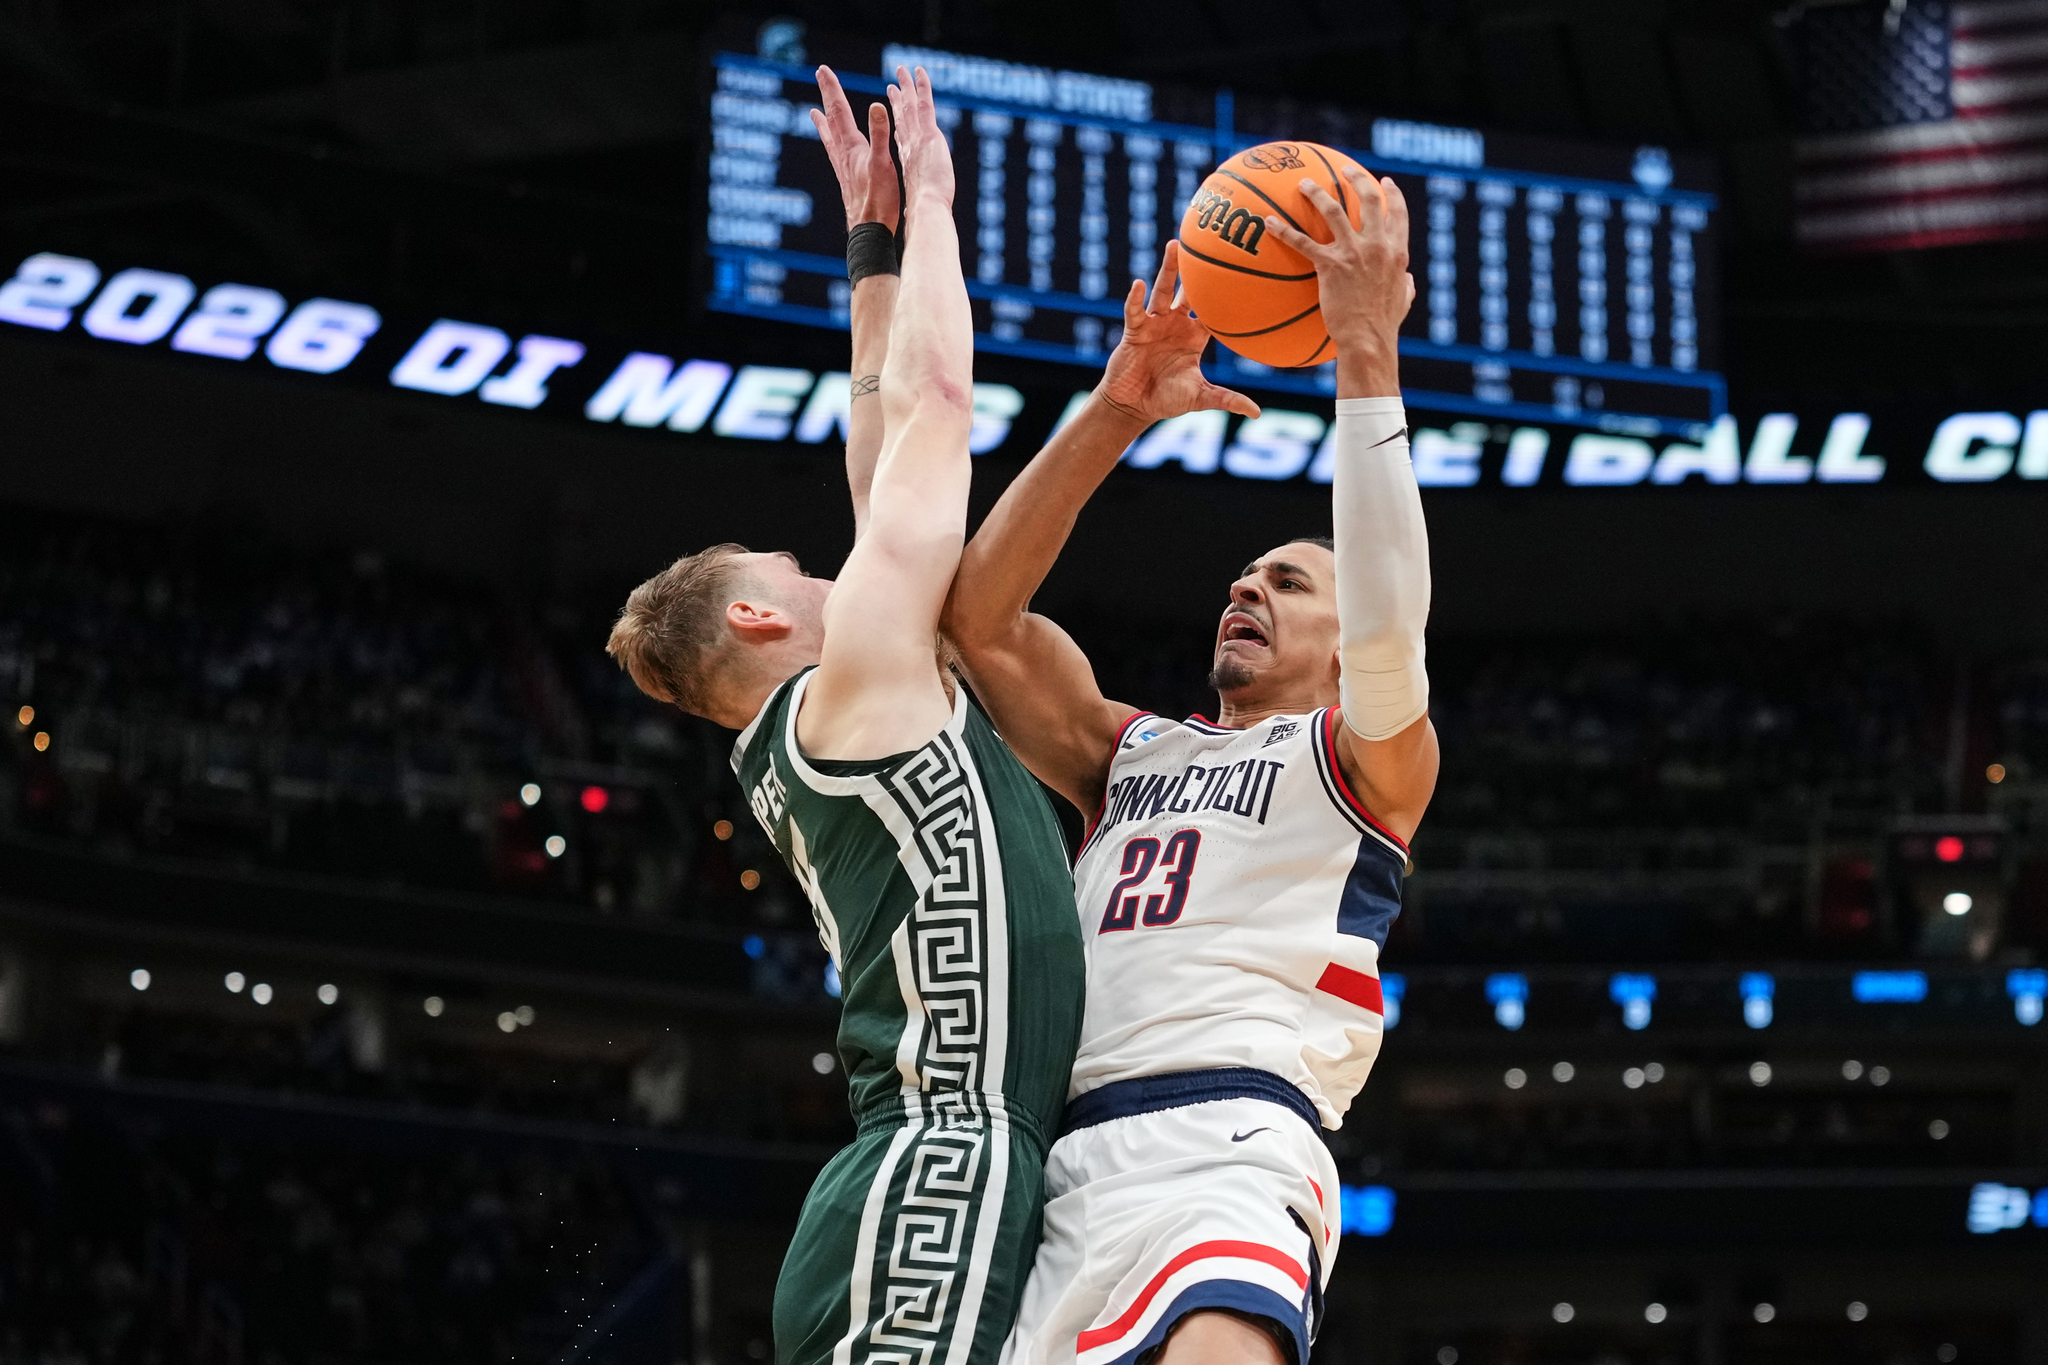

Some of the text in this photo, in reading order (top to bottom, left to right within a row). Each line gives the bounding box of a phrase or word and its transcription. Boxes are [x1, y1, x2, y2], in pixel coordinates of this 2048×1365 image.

[0, 251, 382, 374] 2026
[389, 318, 587, 409] DI
[1270, 722, 1298, 735] BIG
[1104, 759, 1285, 834] CONNCTICUT
[1099, 829, 1201, 935] 23
